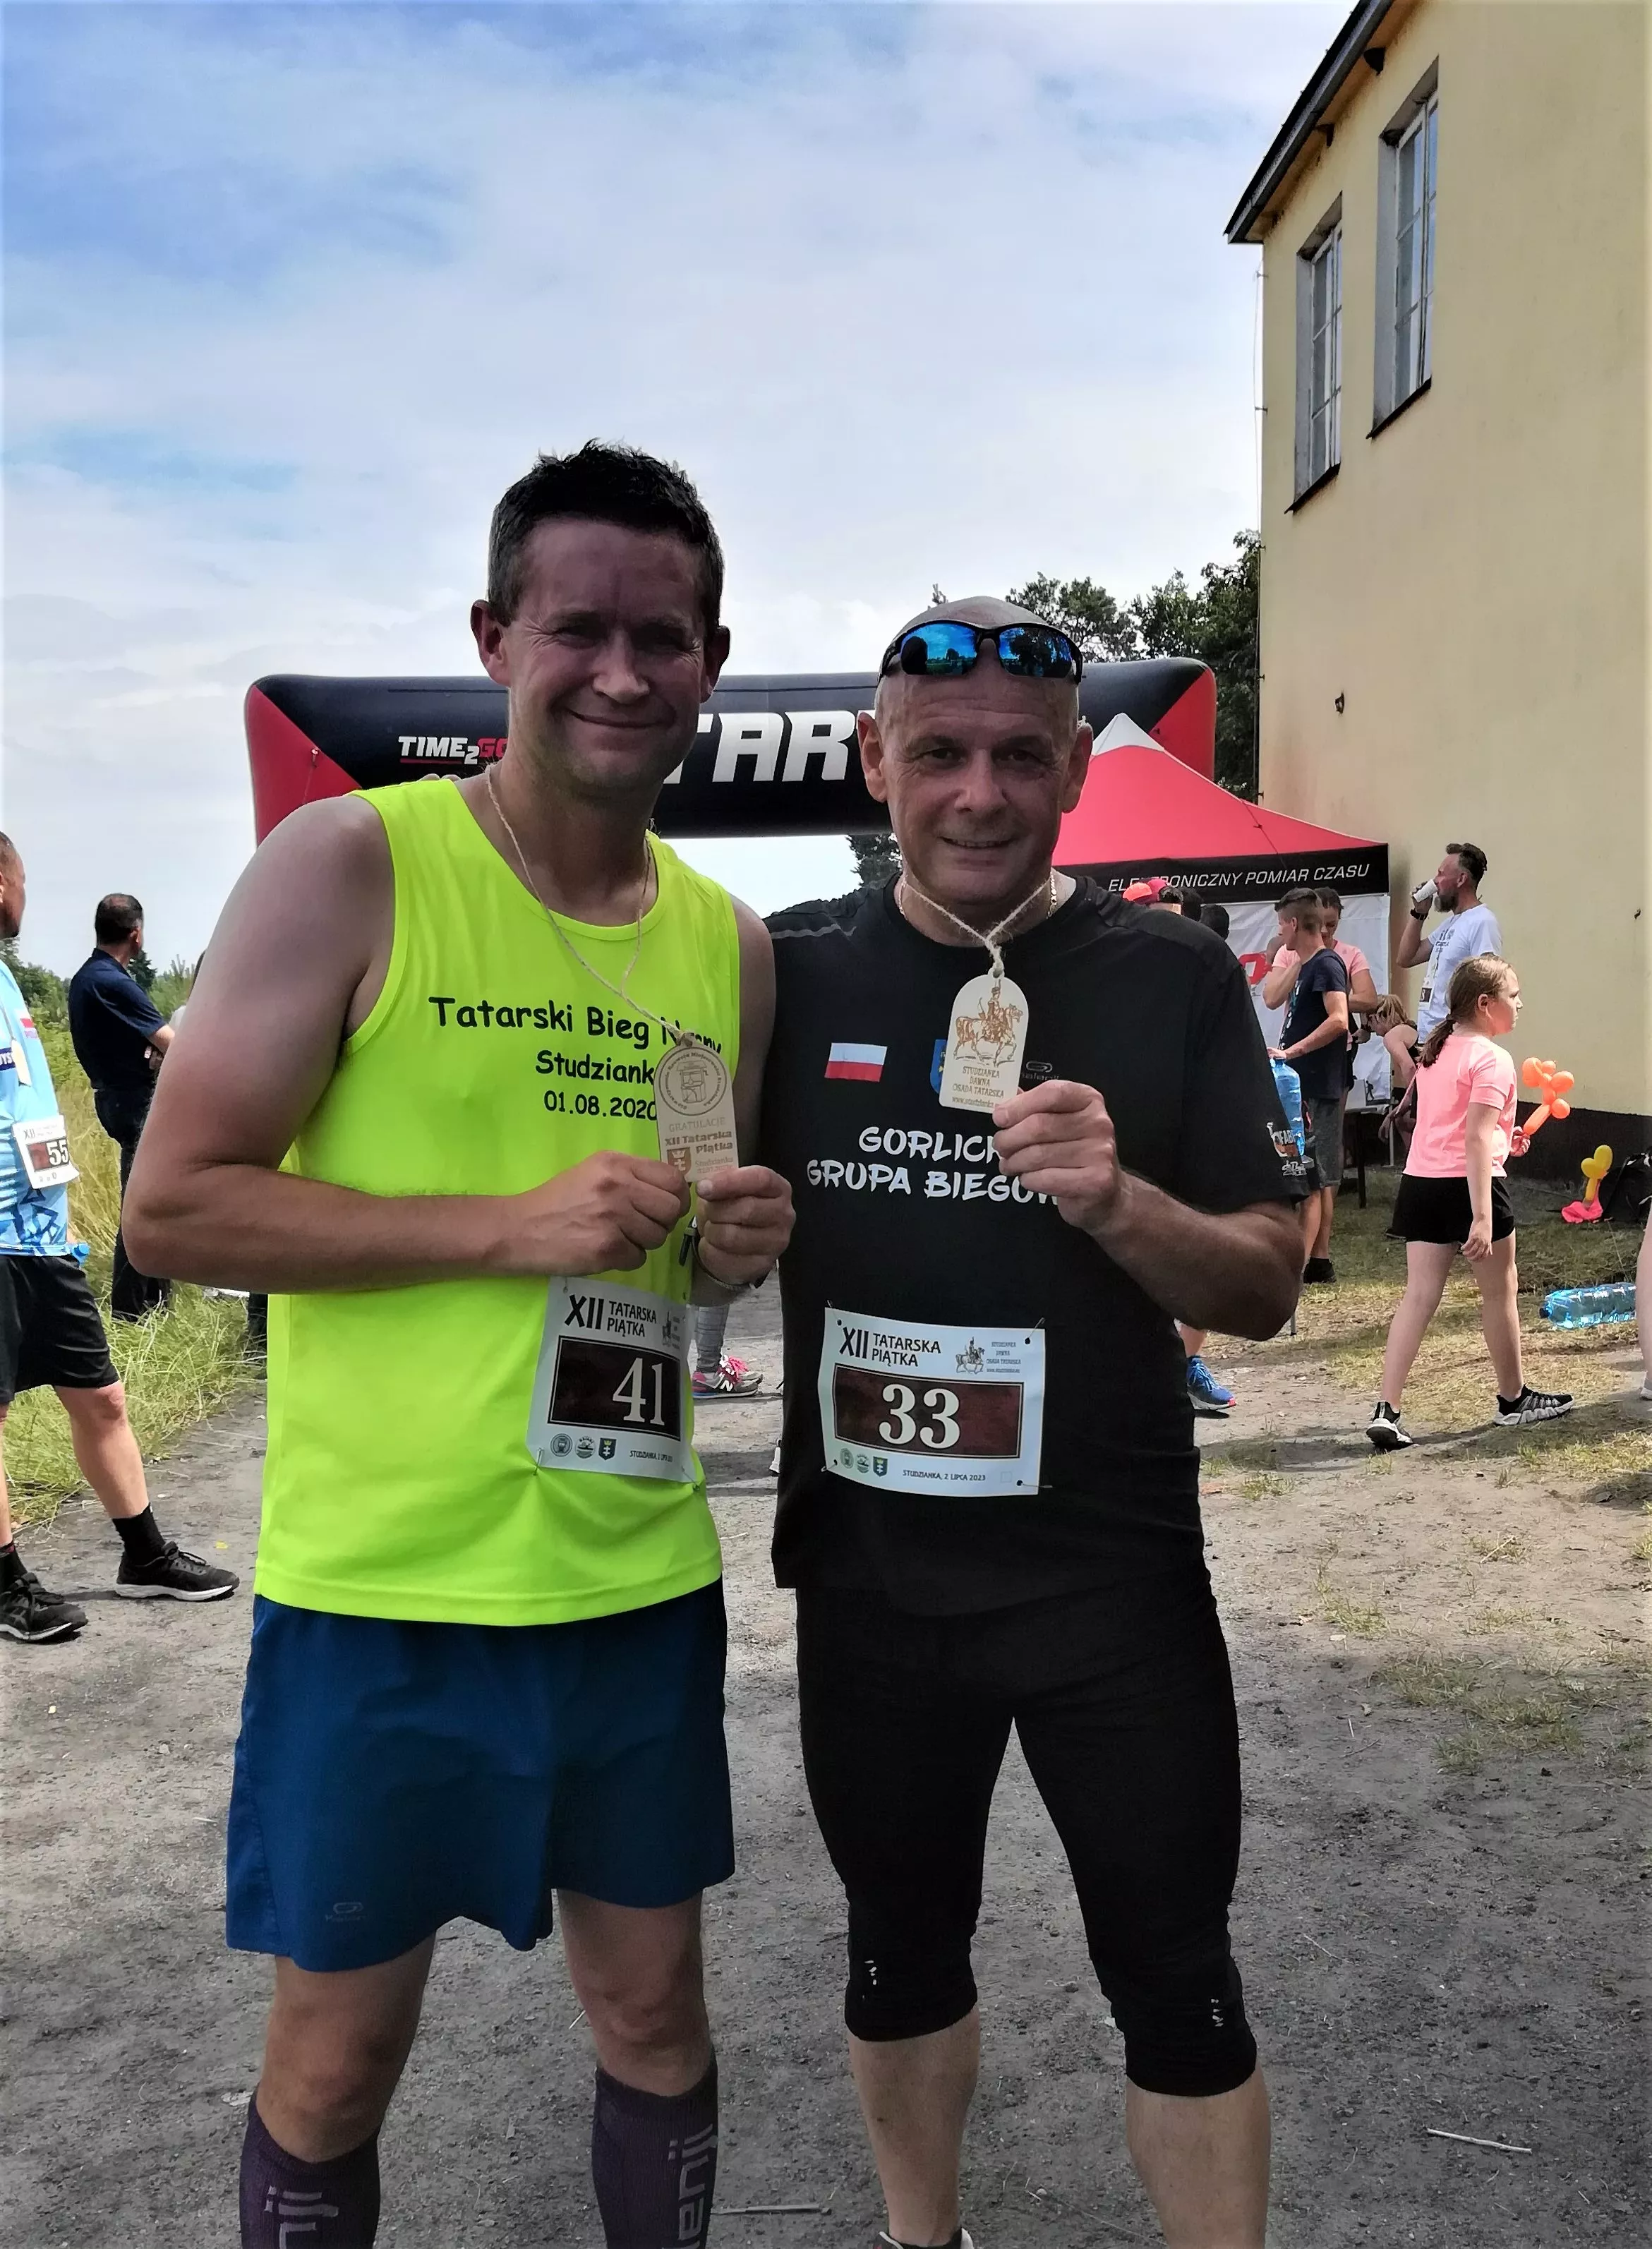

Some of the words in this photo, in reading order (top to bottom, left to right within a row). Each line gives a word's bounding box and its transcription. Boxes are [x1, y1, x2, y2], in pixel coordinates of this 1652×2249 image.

[663, 710, 876, 784] AR
[1246, 868, 1310, 885] POMIAR
[1314, 863, 1370, 881] CZASU
[428, 996, 573, 1032] Tatarski
[587, 1006, 649, 1049] Bieg
[536, 1049, 654, 1085] Studziank
[962, 1066, 1000, 1078] STUDZIANKA
[969, 1076, 991, 1086] DAWNA
[952, 1083, 972, 1093] OSADA
[974, 1087, 1004, 1098] TATARSKA
[544, 1090, 656, 1121] 01.08.2020
[665, 1137, 680, 1146] XII
[682, 1130, 732, 1143] Tatarska
[669, 1117, 726, 1132] GRATULACJE
[47, 1140, 68, 1165] 55
[858, 1126, 1003, 1164] GORLICK
[807, 1159, 912, 1195] GRUPA
[565, 1294, 605, 1329] XII
[609, 1301, 657, 1324] TATARSKA
[606, 1318, 646, 1337] PIĄTKA
[839, 1326, 869, 1359] XII
[873, 1332, 941, 1354] TATARSKA
[872, 1348, 919, 1367] PIĄTKA
[613, 1357, 665, 1425] 41
[879, 1384, 960, 1449] 33
[903, 1469, 943, 1481] STUDZIANKA,
